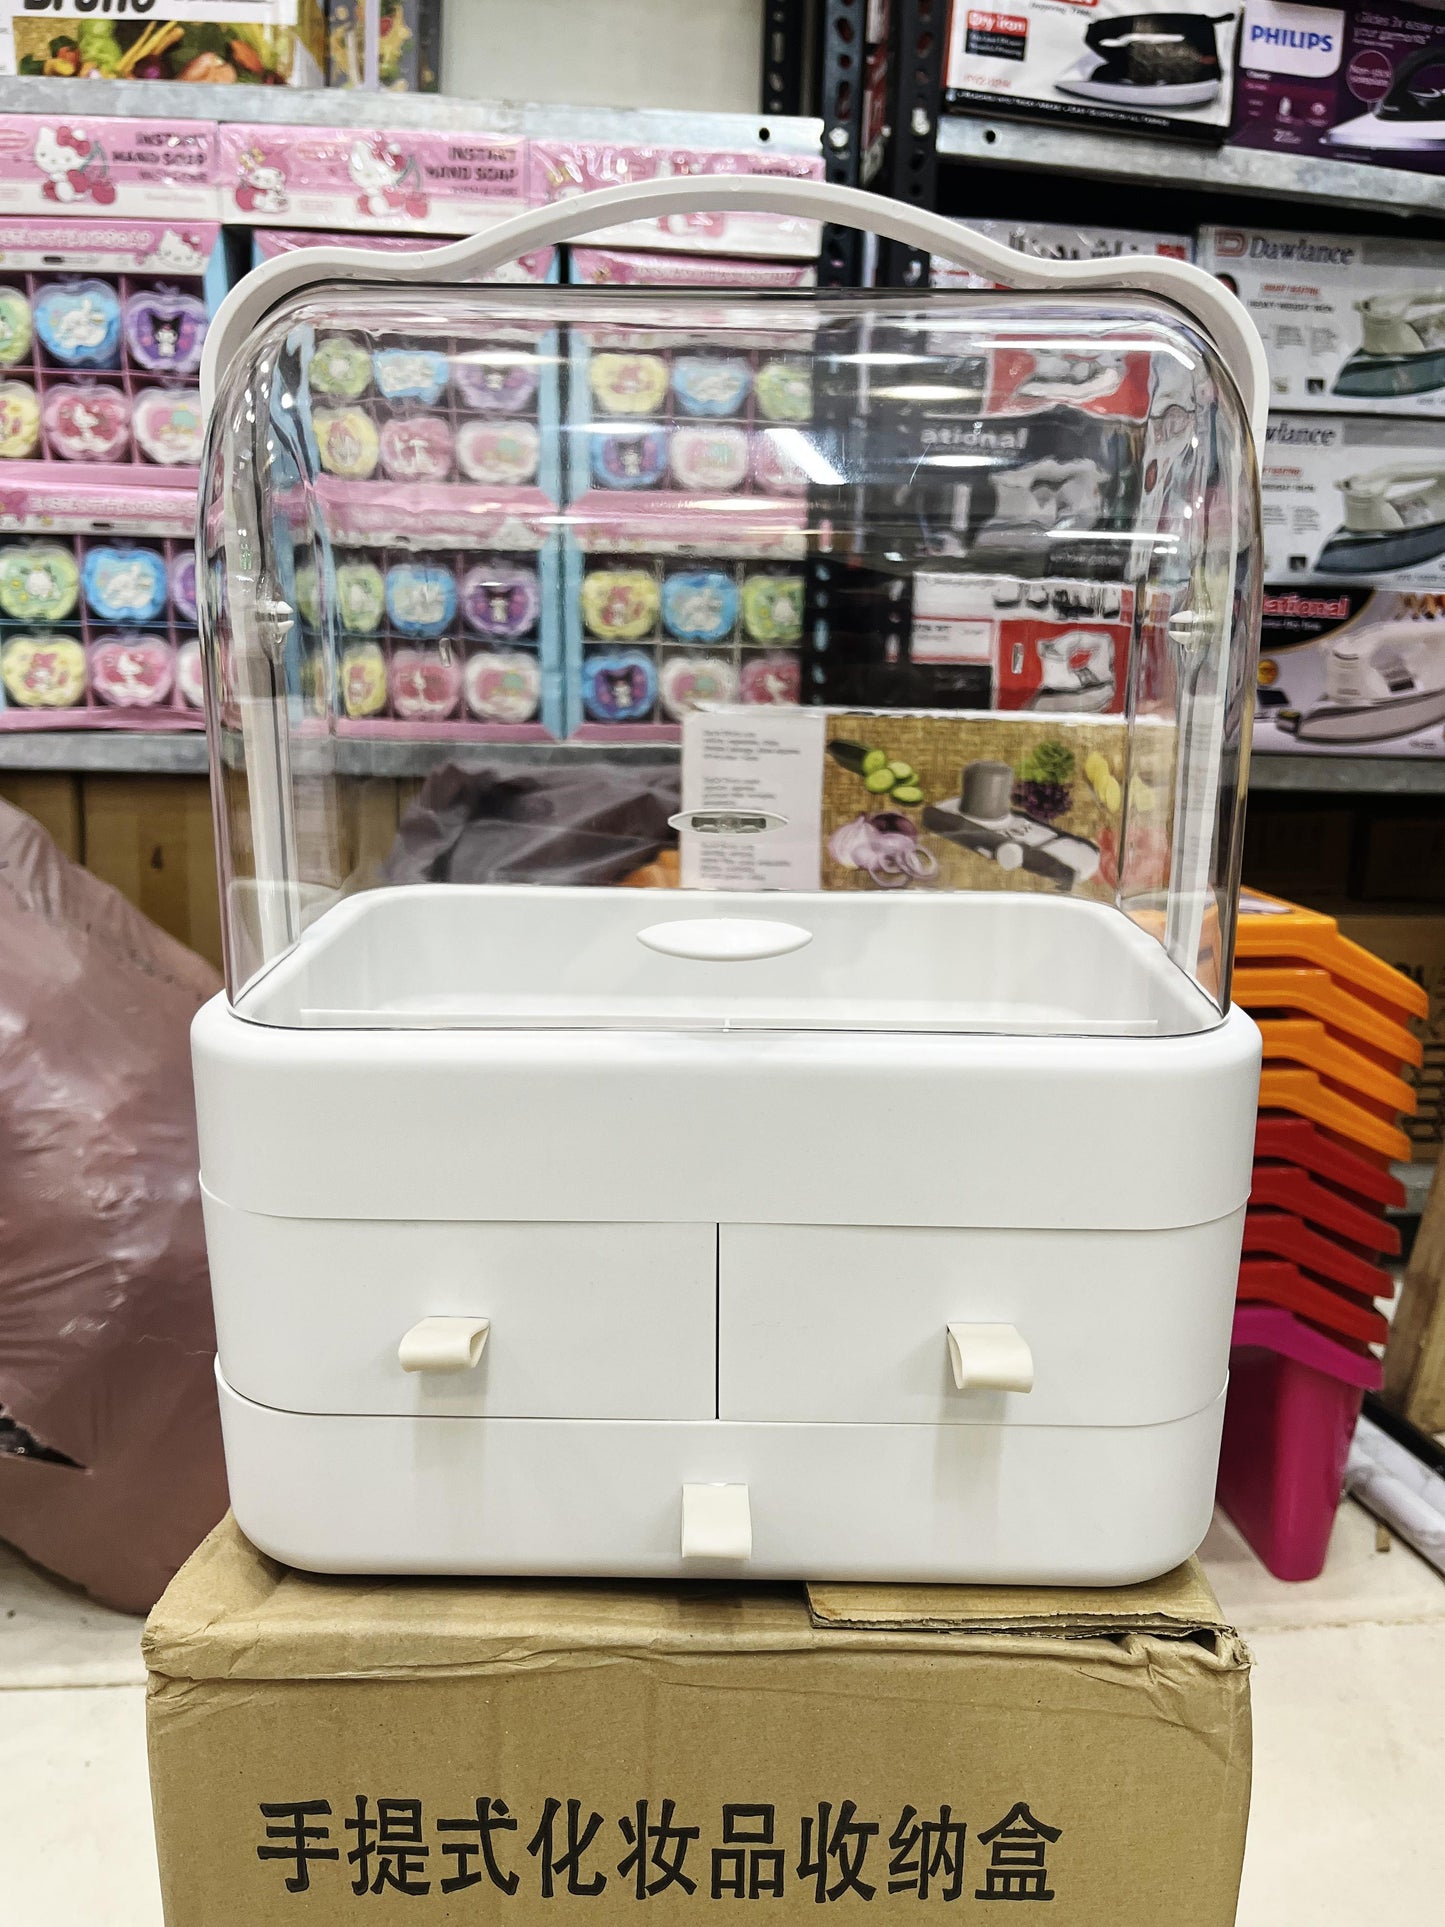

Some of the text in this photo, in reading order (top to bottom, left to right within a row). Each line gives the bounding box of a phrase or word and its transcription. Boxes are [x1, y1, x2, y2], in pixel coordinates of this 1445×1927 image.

[1251, 24, 1333, 52] PHILIPS
[1250, 236, 1354, 266] Dawlance
[920, 426, 1029, 449] ational
[257, 1795, 1063, 1902] 手提式化妆品收纳盒
